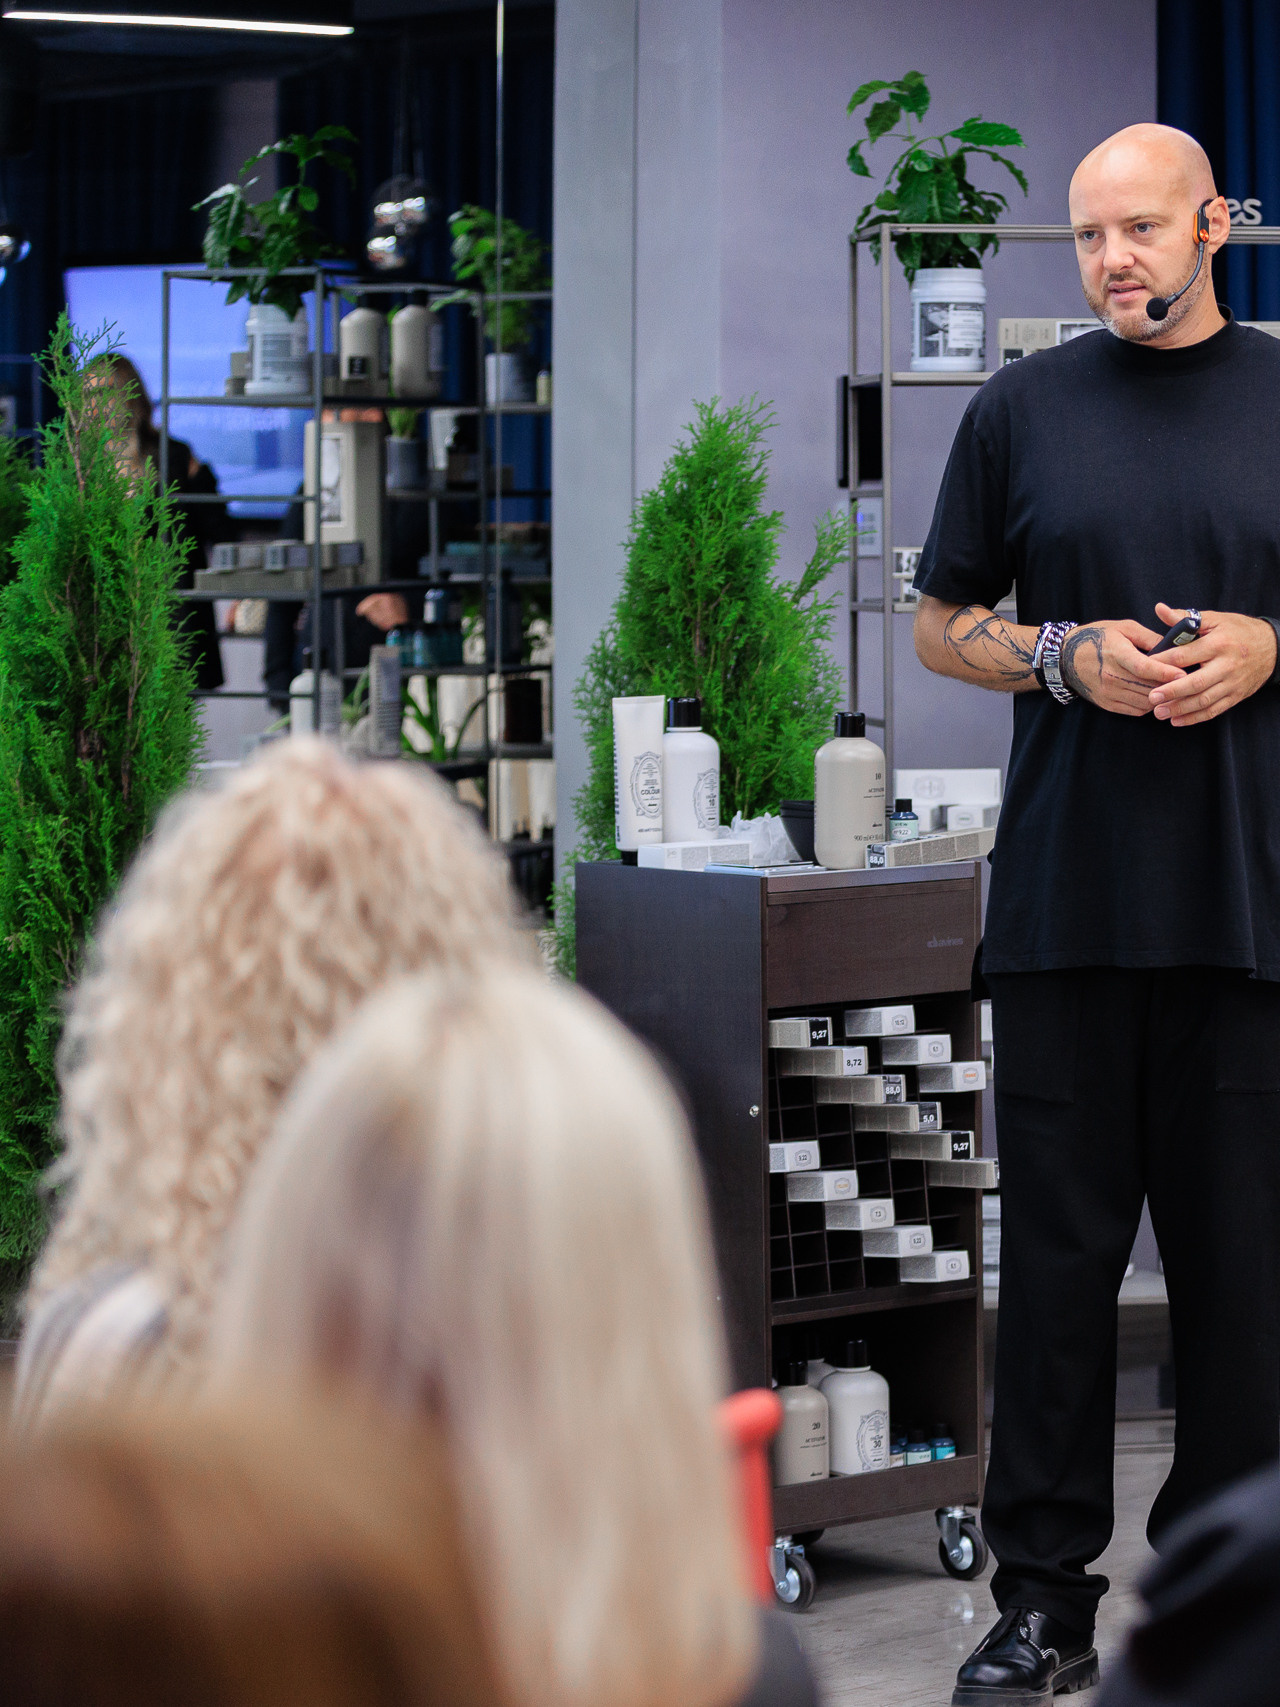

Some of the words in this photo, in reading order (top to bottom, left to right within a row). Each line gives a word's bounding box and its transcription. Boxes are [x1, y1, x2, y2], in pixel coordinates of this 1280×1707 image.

[875, 772, 881, 780] 10
[869, 855, 884, 865] 88,0
[926, 936, 964, 948] davines
[811, 1029, 827, 1040] 9,27
[846, 1059, 862, 1067] 8,72
[885, 1086, 901, 1095] 88,0
[923, 1114, 934, 1123] 5,0
[953, 1142, 969, 1152] 9,27
[812, 1422, 821, 1430] 20
[873, 1440, 882, 1449] 30
